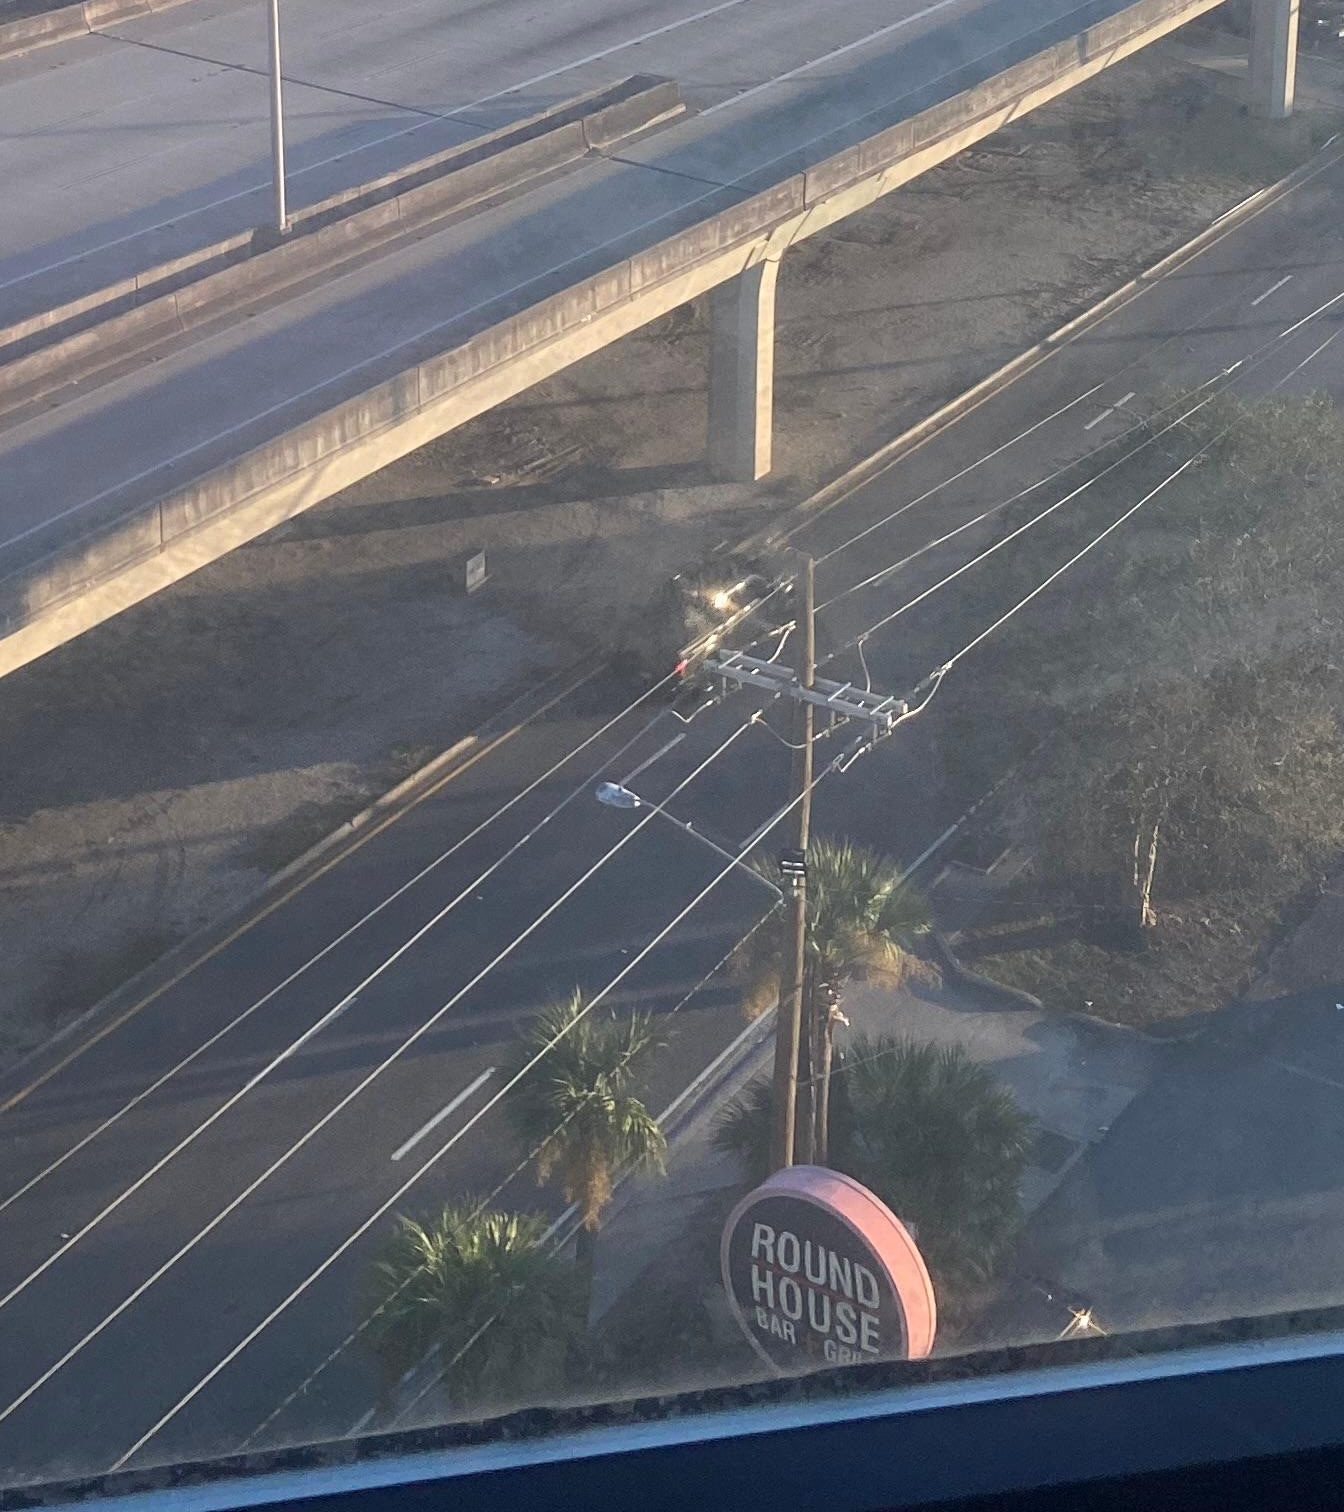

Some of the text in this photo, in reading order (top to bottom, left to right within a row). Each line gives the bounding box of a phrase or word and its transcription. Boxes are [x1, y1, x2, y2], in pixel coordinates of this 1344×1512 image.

[751, 1222, 880, 1309] ROUND
[751, 1264, 880, 1355] HOUSE
[755, 1305, 797, 1345] BAR
